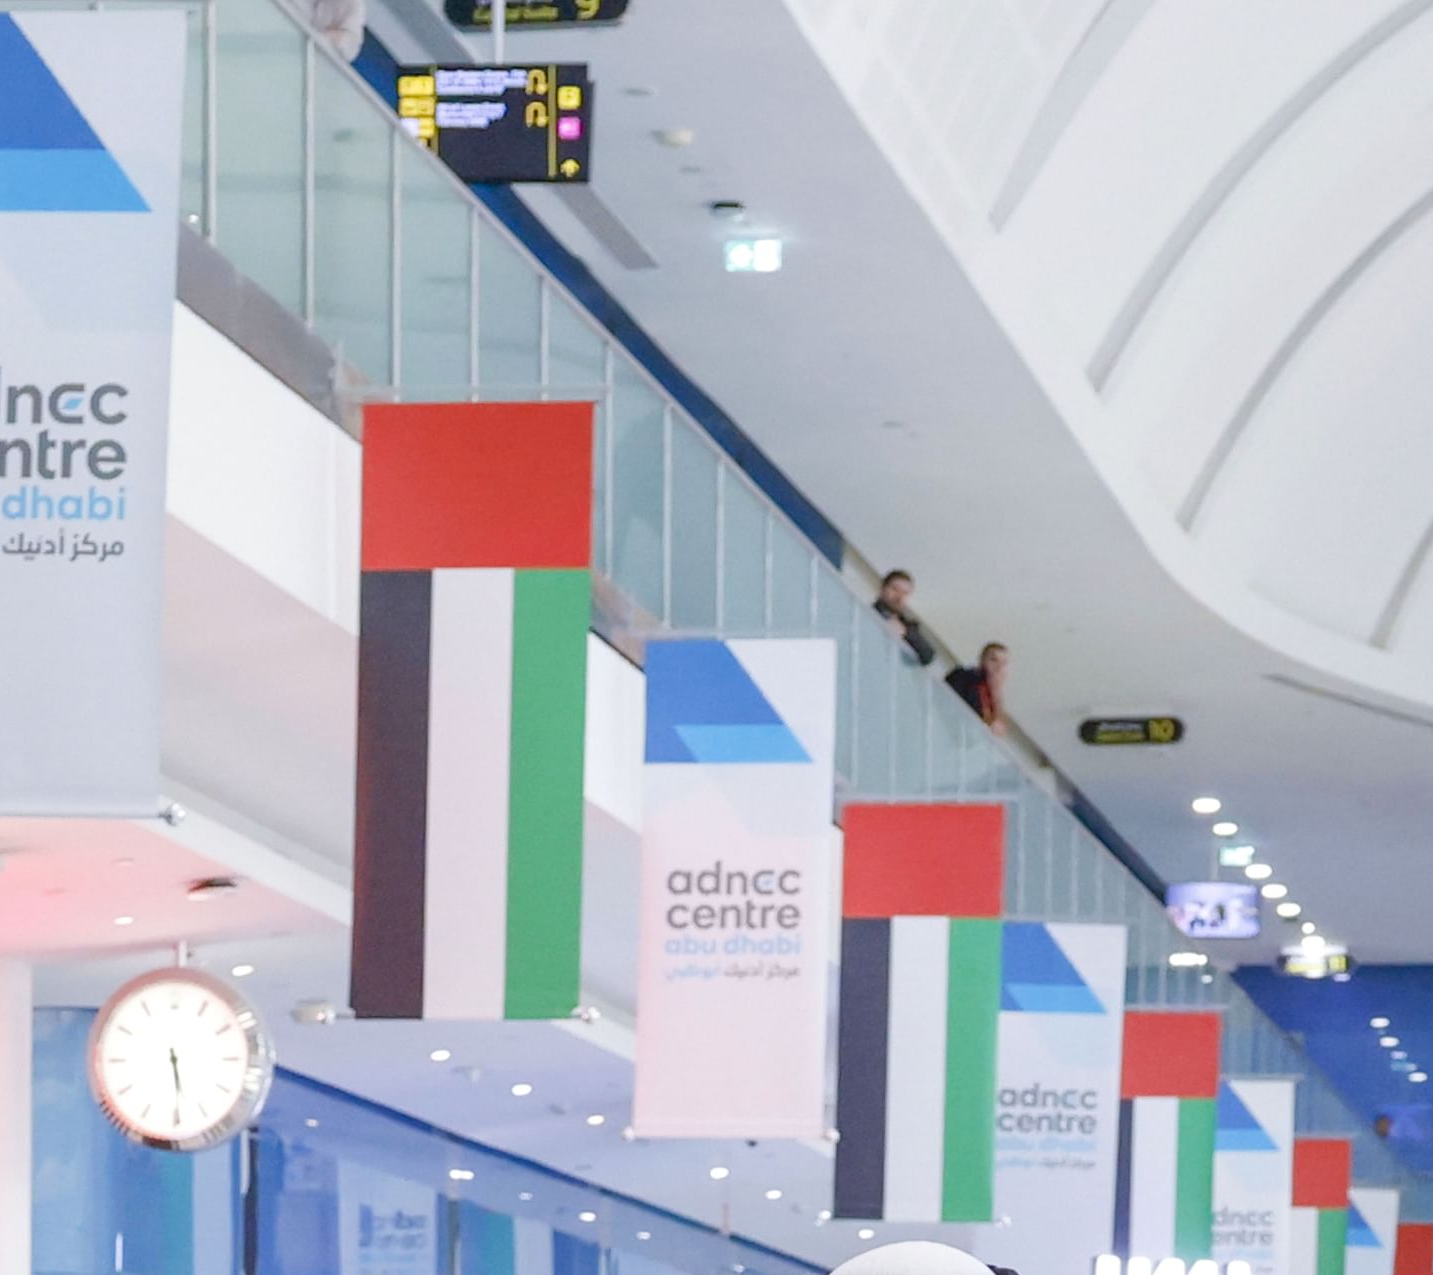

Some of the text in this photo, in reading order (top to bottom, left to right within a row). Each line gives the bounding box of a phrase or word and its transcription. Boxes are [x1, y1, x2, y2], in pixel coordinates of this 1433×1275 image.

[1, 485, 126, 521] dhabi
[1, 527, 66, 562] أدنيك
[69, 532, 125, 562] مركز
[666, 900, 801, 929] centre
[997, 1112, 1097, 1135] centre
